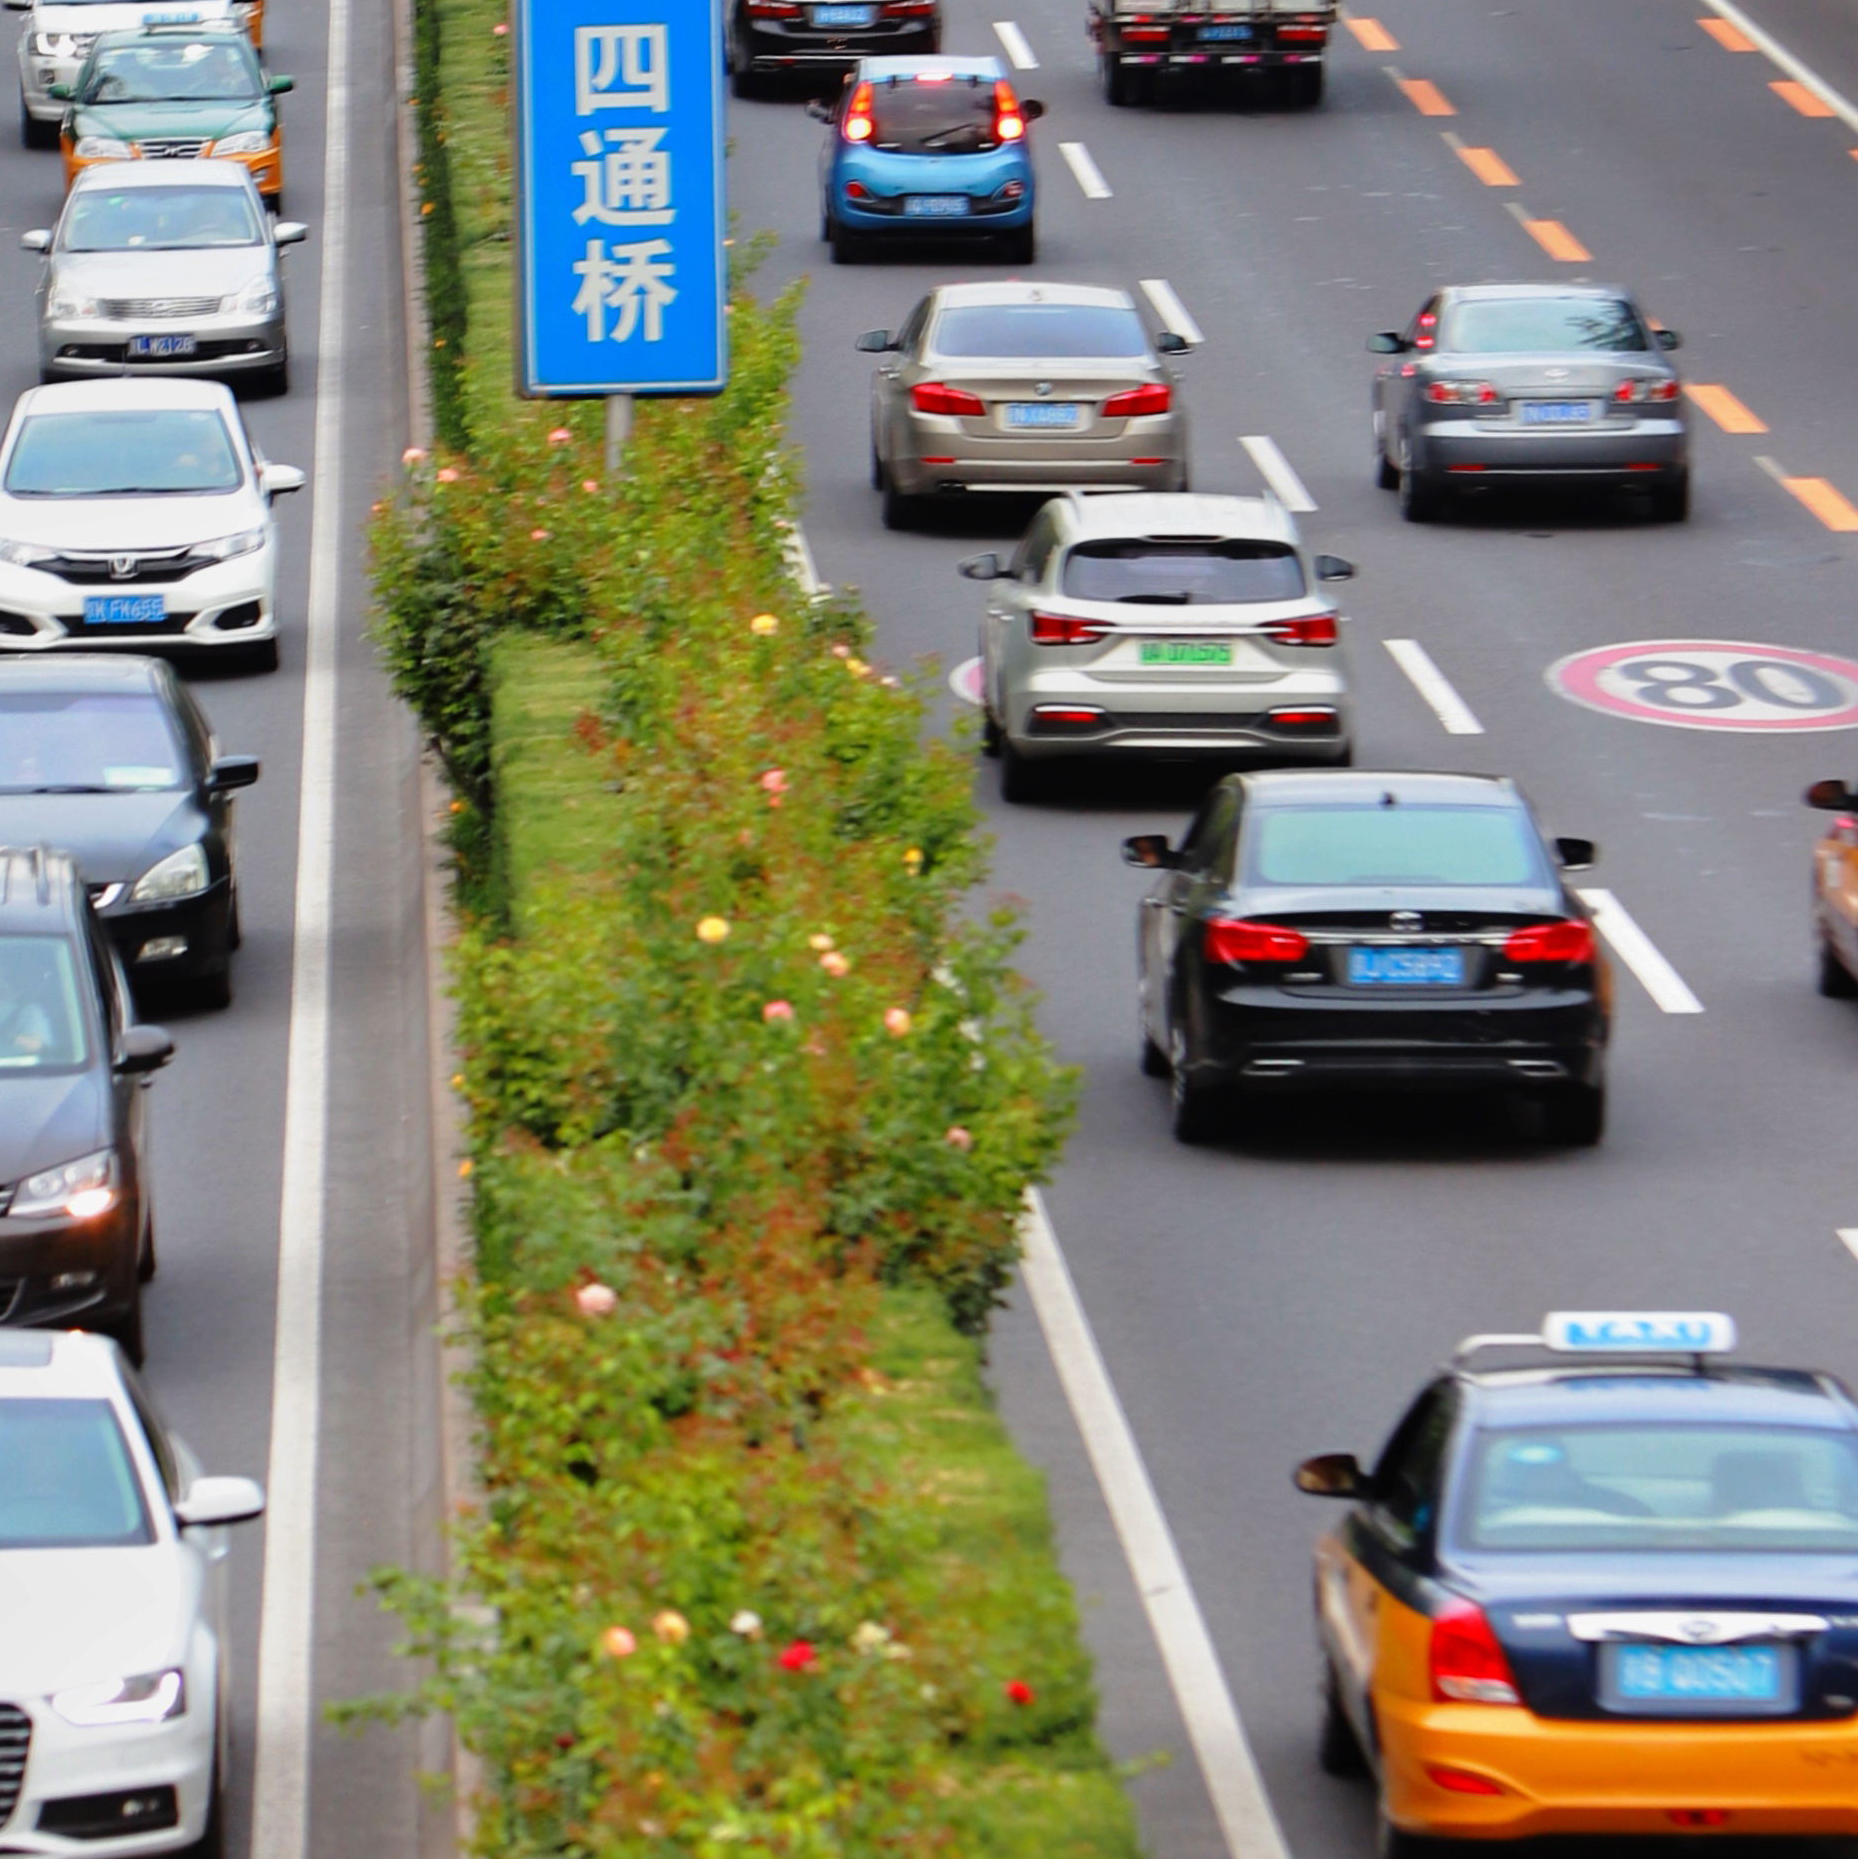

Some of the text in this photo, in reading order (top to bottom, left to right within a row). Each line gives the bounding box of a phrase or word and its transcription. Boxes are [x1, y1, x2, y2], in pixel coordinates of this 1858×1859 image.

[570, 24, 678, 344] 四通桥
[1618, 660, 1847, 710] 80
